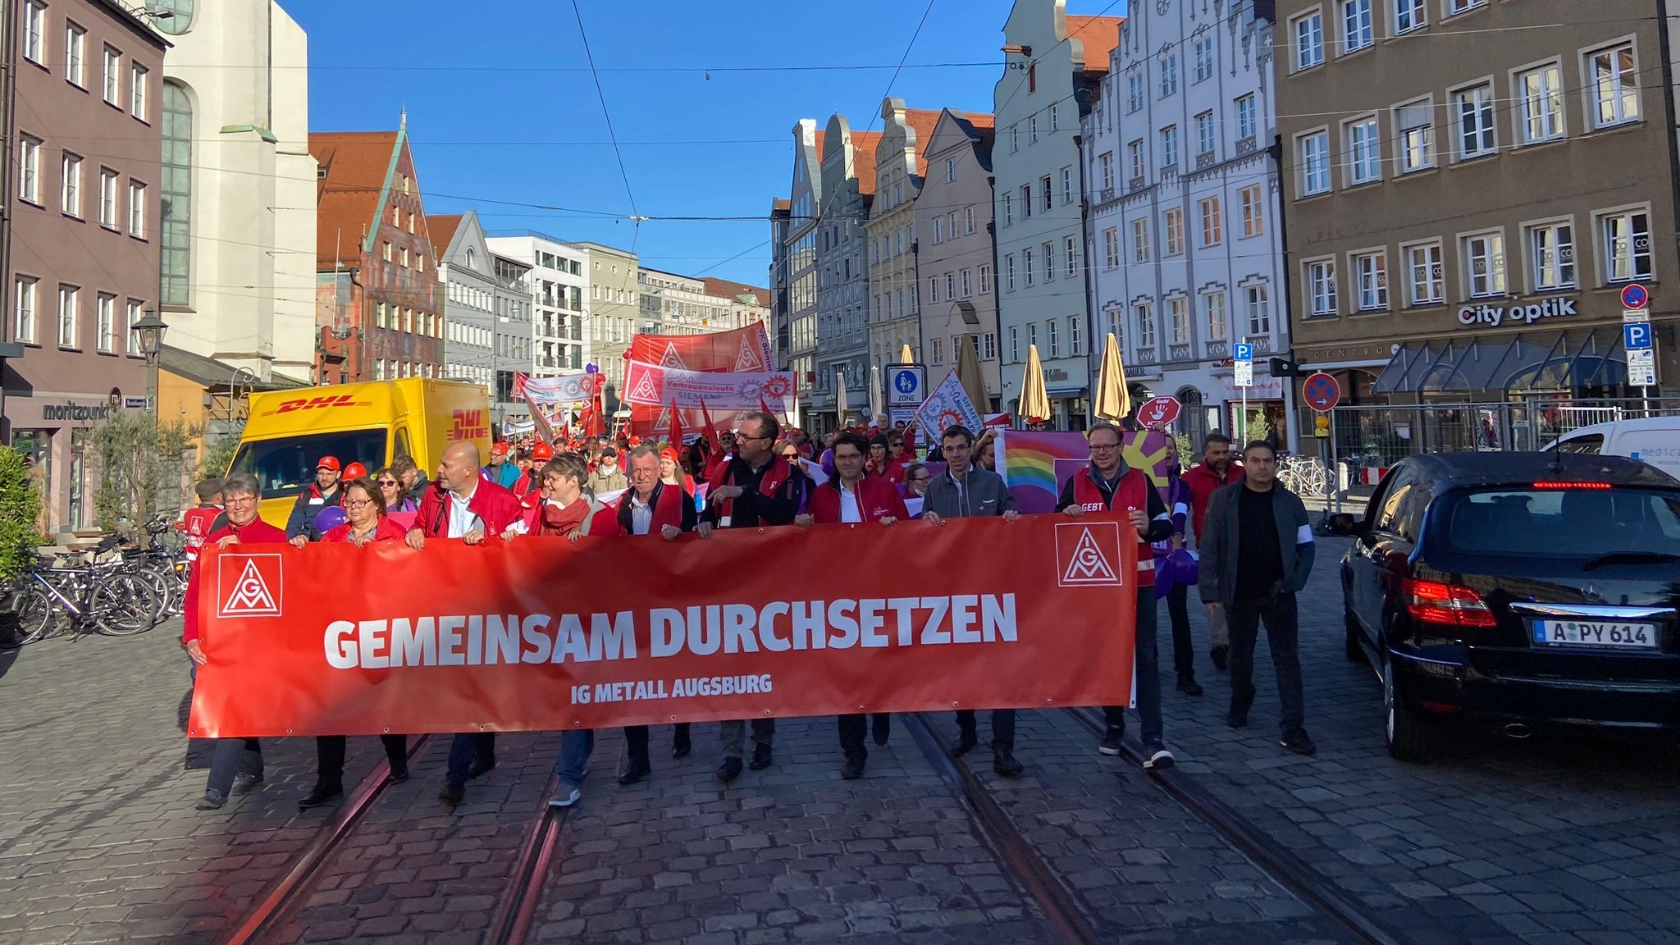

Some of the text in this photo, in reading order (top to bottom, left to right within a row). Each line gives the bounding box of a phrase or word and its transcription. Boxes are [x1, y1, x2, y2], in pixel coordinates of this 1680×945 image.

[1457, 297, 1577, 326] City optik
[1629, 326, 1645, 346] P
[1237, 345, 1248, 359] P
[666, 380, 734, 392] Vertrauensleute
[275, 394, 357, 414] DHL
[452, 408, 484, 441] DHL
[1081, 502, 1104, 512] GEBT
[323, 592, 1019, 670] GEMEINSAM DURCHSETZEN
[1553, 622, 1648, 644] A PY 614
[571, 674, 773, 705] IG METALL AUGSBURG
